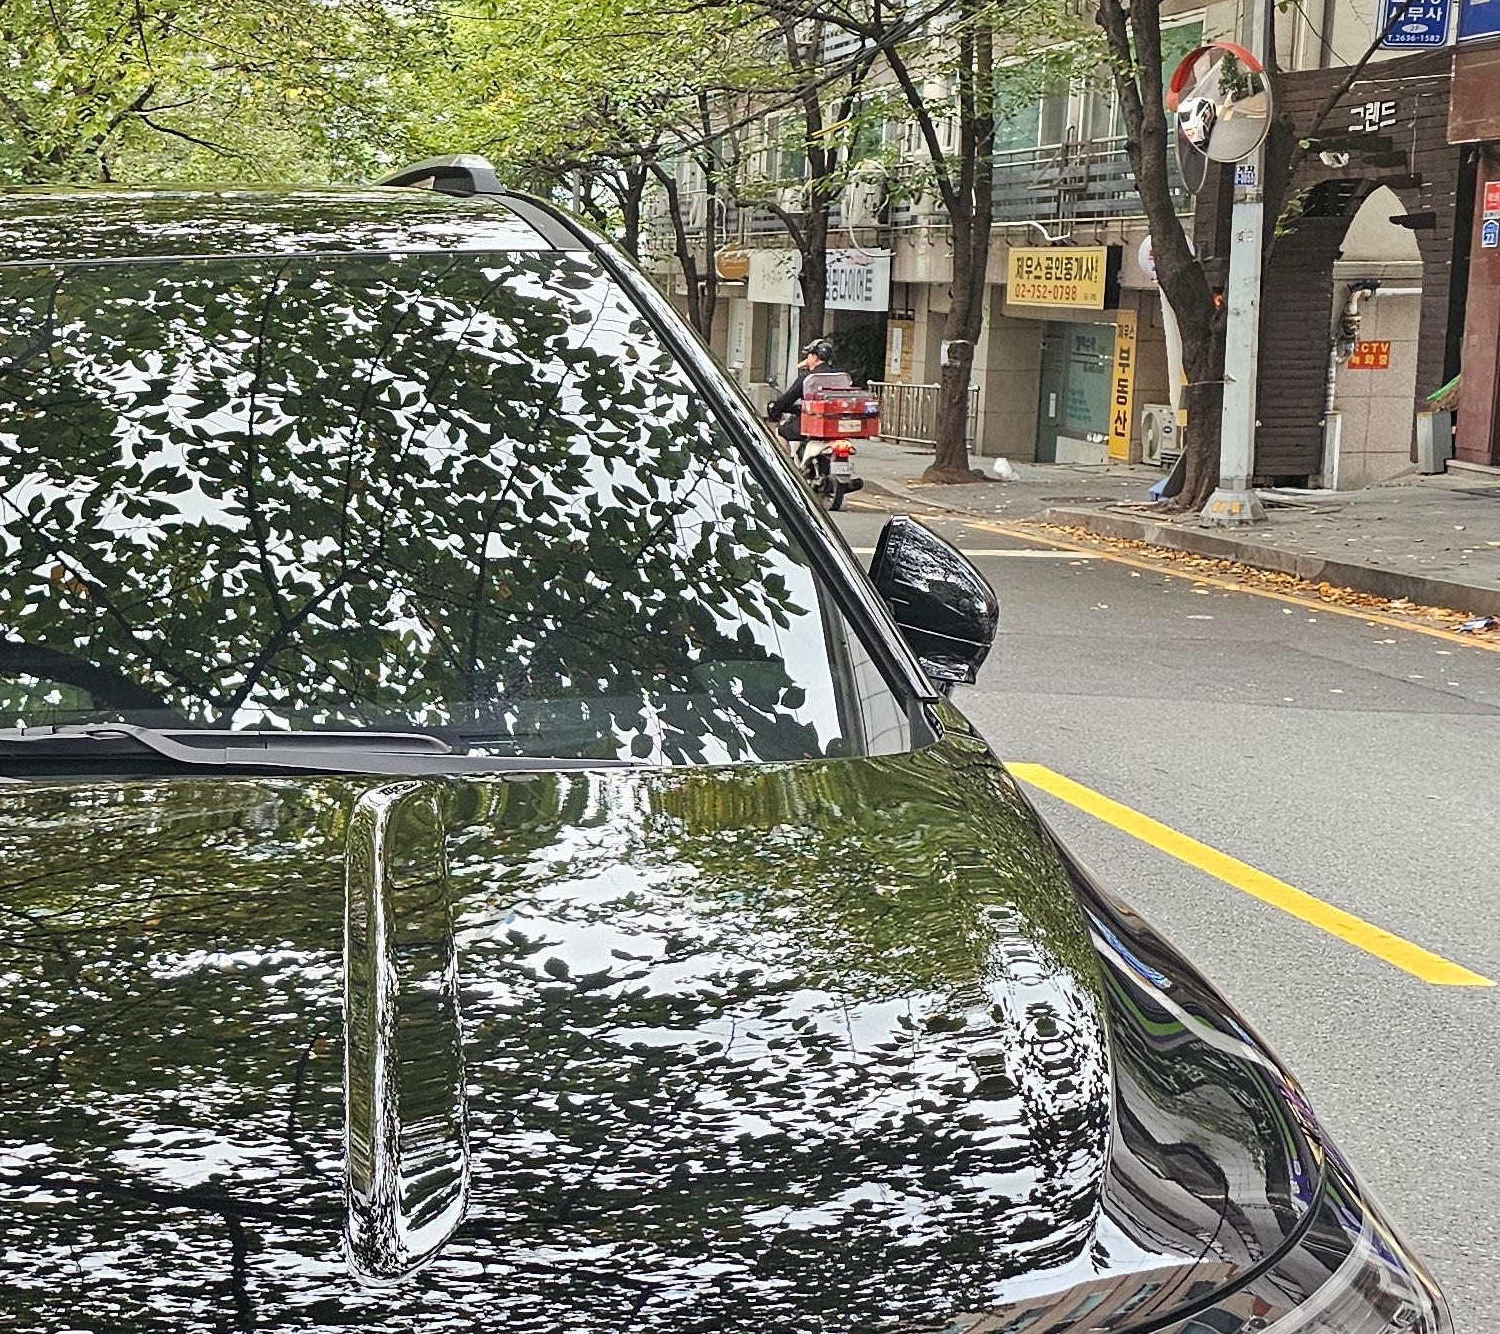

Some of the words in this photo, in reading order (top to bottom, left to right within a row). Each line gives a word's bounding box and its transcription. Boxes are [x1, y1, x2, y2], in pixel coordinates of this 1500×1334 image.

[1387, 34, 1441, 42] T.2636-1582
[1015, 256, 1094, 282] 제우스공인중개사
[1015, 283, 1077, 301] 02-752-0798
[1113, 347, 1131, 438] 부동산
